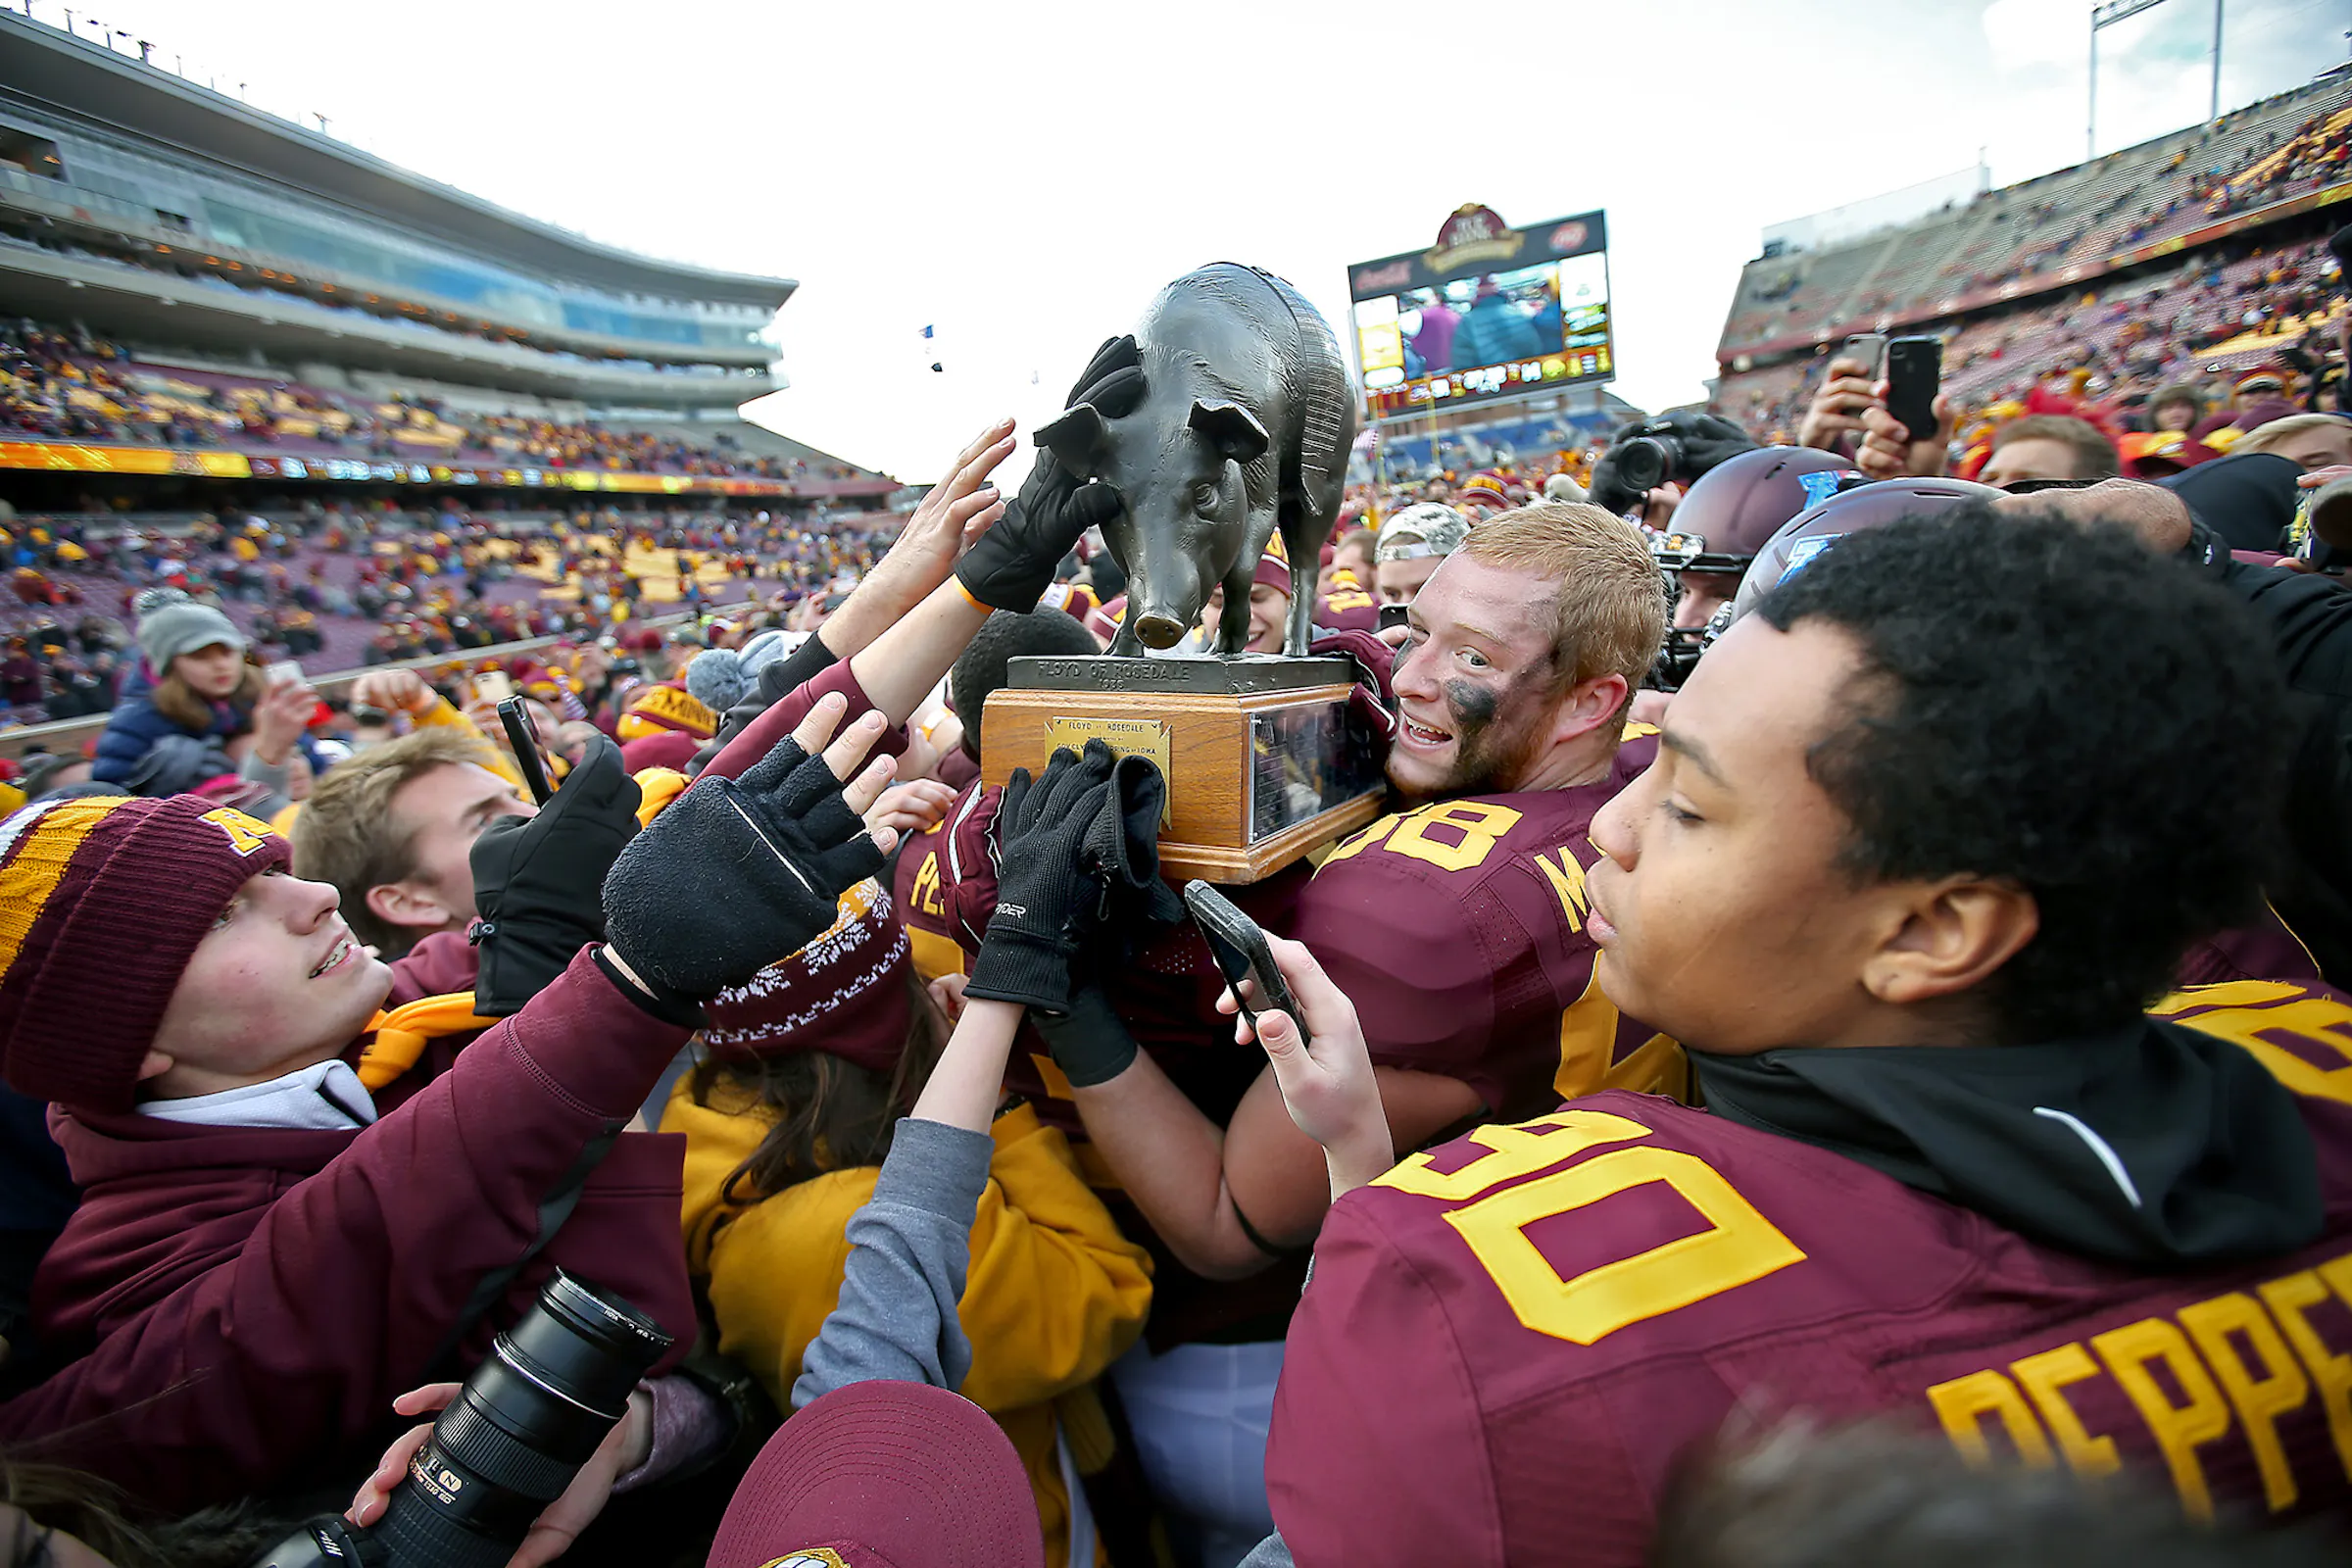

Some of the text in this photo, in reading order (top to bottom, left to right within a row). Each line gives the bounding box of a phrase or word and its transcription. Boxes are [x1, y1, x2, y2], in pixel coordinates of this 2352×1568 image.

[1037, 661, 1082, 677] FLOYD
[1114, 663, 1191, 682] ROSEDALE
[1068, 721, 1093, 731] FLOYD
[1107, 722, 1145, 733] ROSEDALE
[910, 851, 946, 915] PE
